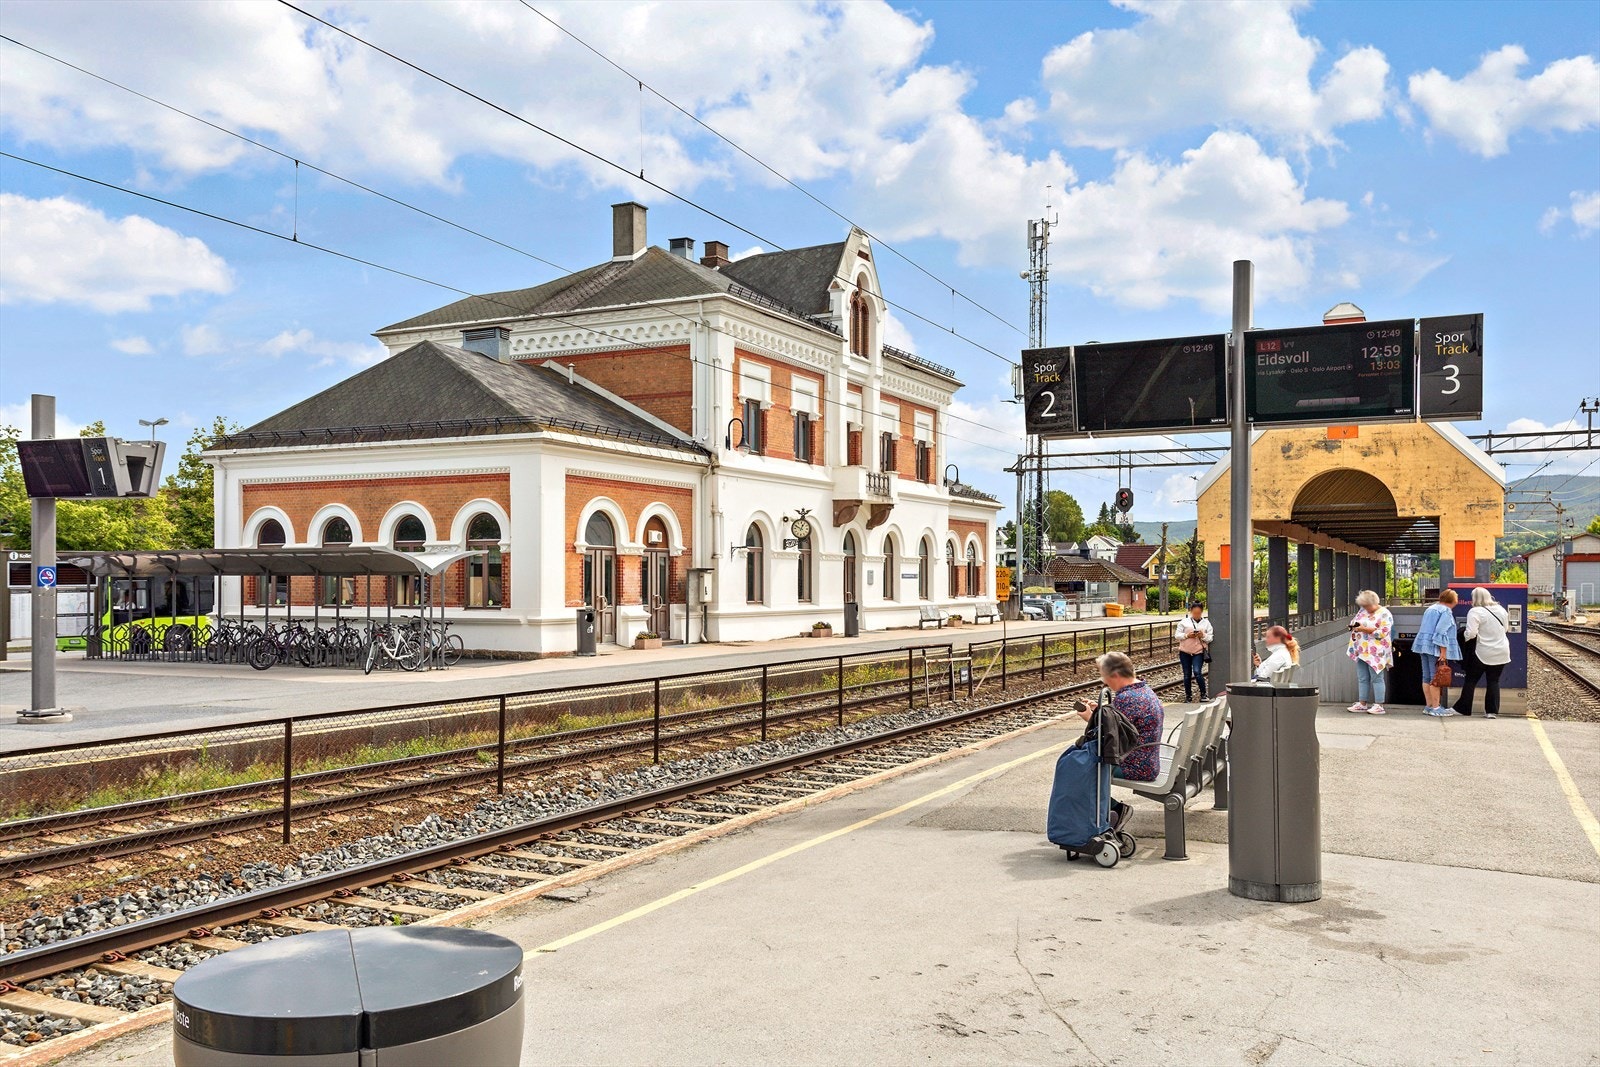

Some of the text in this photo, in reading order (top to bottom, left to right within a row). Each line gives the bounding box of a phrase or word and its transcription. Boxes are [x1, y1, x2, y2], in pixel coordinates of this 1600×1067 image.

[1377, 329, 1400, 338] 12:49
[1435, 332, 1464, 345] Spor
[1191, 344, 1213, 352] 12:49
[1361, 344, 1400, 358] 12:59
[1434, 343, 1469, 356] Track
[1257, 350, 1310, 366] Eidsvoll
[1034, 362, 1056, 374] Spor
[1326, 364, 1346, 372] Airport
[1370, 360, 1400, 370] 13:03
[1034, 372, 1061, 383] Track
[1441, 364, 1460, 394] 3
[1040, 390, 1056, 418] 2
[98, 468, 106, 486] 1
[176, 1010, 190, 1029] aste
